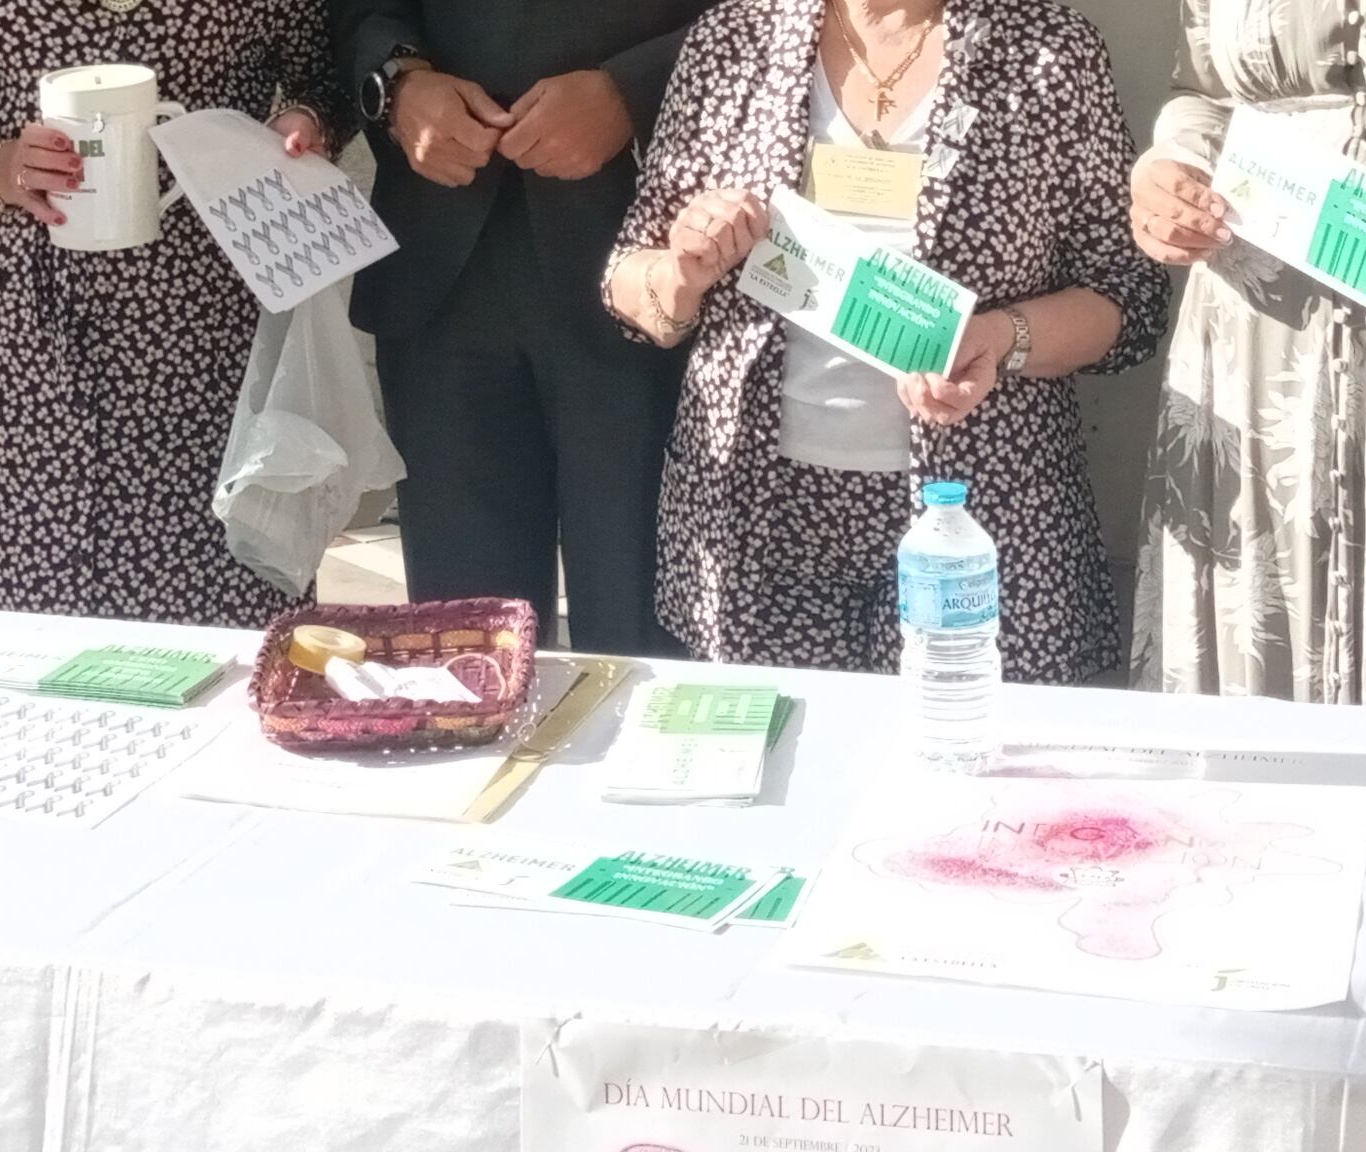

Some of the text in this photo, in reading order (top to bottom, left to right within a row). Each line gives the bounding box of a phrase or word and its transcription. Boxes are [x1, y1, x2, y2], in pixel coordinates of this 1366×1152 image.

[79, 139, 105, 158] DEL
[1228, 152, 1317, 206] ALZHEIMER
[766, 228, 846, 282] ALZHEIMER
[865, 247, 959, 313] ALZHEIMER
[612, 850, 752, 881] ALZHEIMER
[603, 1078, 1015, 1138] DÍA MUNDIAL DEL ALZHEIMER
[738, 1134, 749, 1146] 21
[753, 1135, 769, 1147] DE
